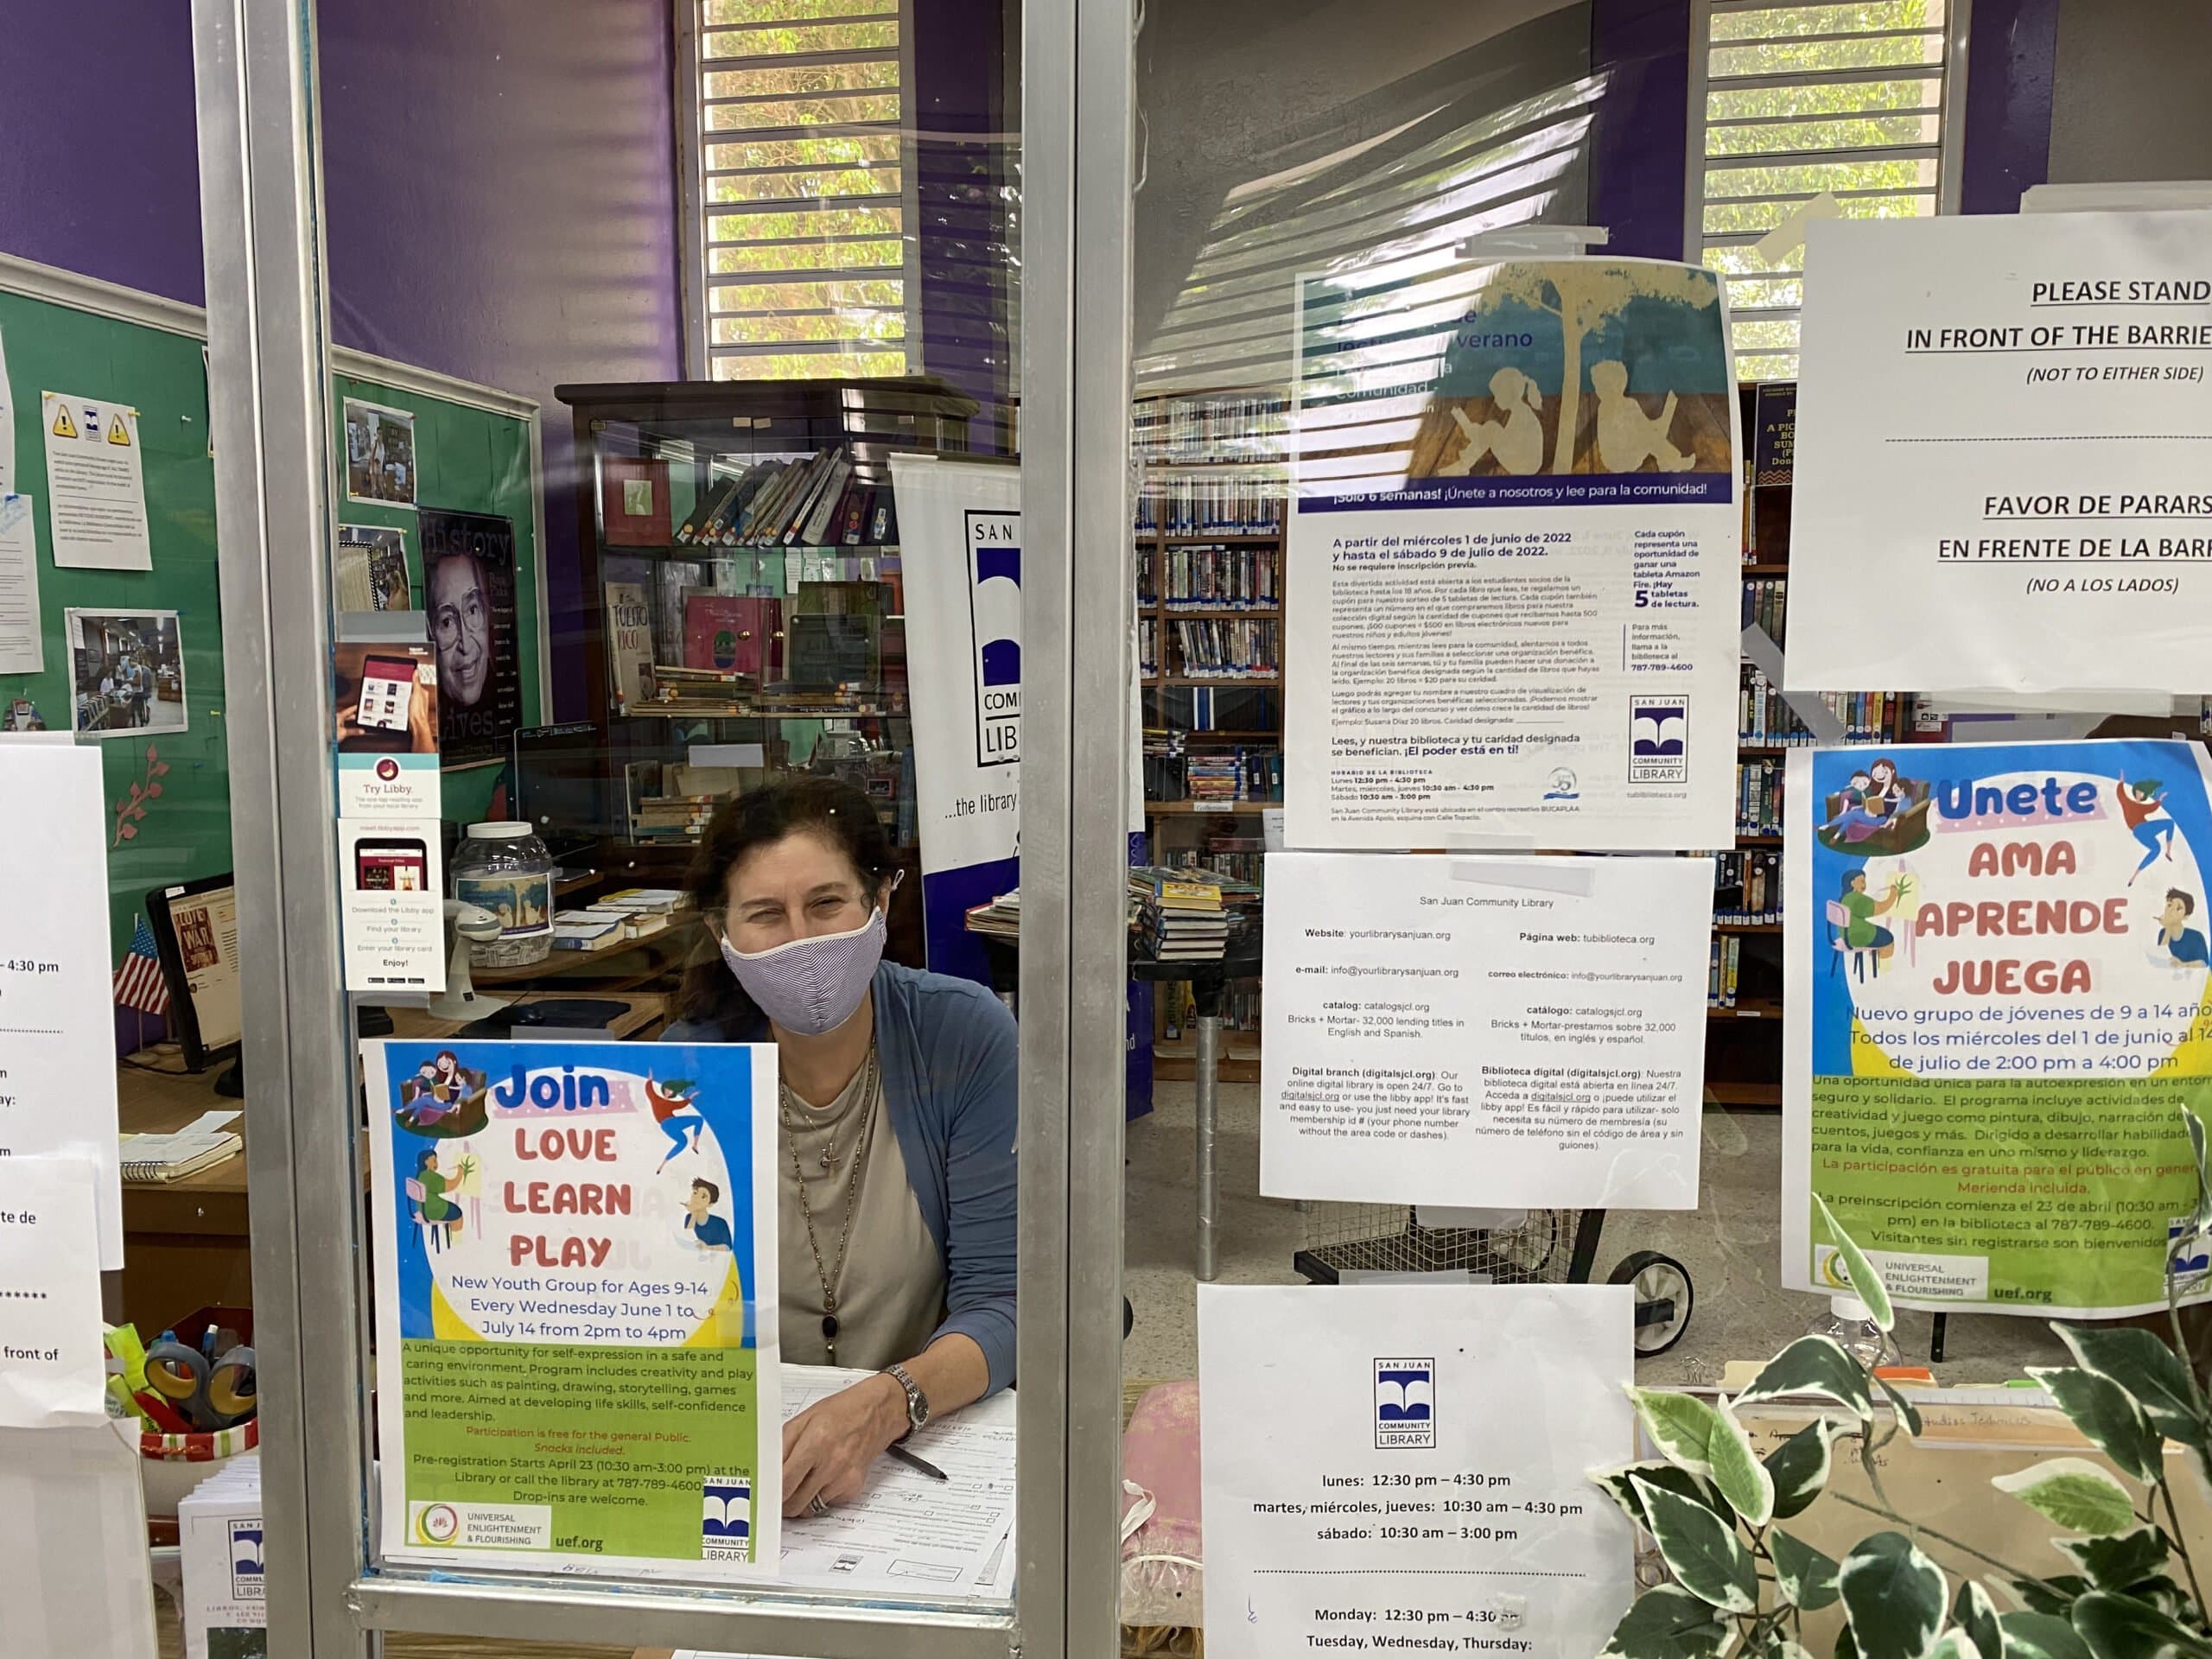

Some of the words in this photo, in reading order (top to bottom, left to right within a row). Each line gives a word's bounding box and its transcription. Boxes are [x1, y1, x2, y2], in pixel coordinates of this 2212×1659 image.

[2033, 280, 2120, 302] PLEASE
[2129, 281, 2210, 301] STAND
[1457, 333, 1532, 348] verano
[1908, 329, 1931, 348] IN
[1941, 328, 2023, 348] FRONT
[2031, 327, 2063, 346] OF
[2073, 325, 2119, 346] THE
[2027, 367, 2071, 385] (NOT
[2076, 367, 2098, 381] TO
[2103, 366, 2159, 380] EITHER
[2164, 366, 2203, 383] SIDE)
[1445, 486, 1485, 501] ¡Únete
[1490, 490, 1497, 499] a
[1500, 486, 1554, 499] nosotros
[1555, 489, 1564, 500] y
[1567, 486, 1586, 498] lee
[1589, 487, 1617, 499] para
[1620, 485, 1630, 496] la
[1633, 482, 1707, 496] comunidad!
[1986, 496, 2069, 515] FAVOR
[2079, 495, 2111, 514] DE
[975, 523, 1013, 541] SAN
[424, 518, 511, 566] History
[1940, 539, 1969, 558] EN
[1979, 539, 2070, 557] FRENTE
[2080, 538, 2111, 557] DE
[2121, 538, 2150, 557] LA
[1333, 561, 1344, 572] No
[1359, 562, 1395, 572] requiere
[1398, 562, 1445, 571] inscripción
[1447, 560, 1477, 571] previa.
[2027, 578, 2059, 595] (NO
[2063, 579, 2075, 592] A
[2082, 579, 2113, 592] LOS
[2118, 577, 2178, 594] LADOS)
[1635, 590, 1649, 608] 5
[1631, 663, 1693, 671] 787-789-4600
[986, 725, 1017, 753] LIB
[1633, 768, 1682, 779] LIBRARY
[363, 785, 380, 794] Try
[979, 791, 1017, 817] library
[1935, 778, 2097, 819] Unete
[1968, 842, 2076, 878] AMA
[1420, 896, 1438, 906] San
[1440, 896, 1464, 906] Juan
[1466, 897, 1519, 909] Community
[1522, 898, 1554, 910] Library
[1916, 898, 2129, 937] APRENDE
[182, 926, 209, 950] WAR
[1350, 930, 1451, 942] yourlibrarysanjuan.org
[1520, 932, 1554, 943] Página
[1556, 933, 1580, 943] web:
[1584, 934, 1655, 946] tubiblioteca.org
[8, 960, 34, 971] 4:30
[39, 963, 58, 975] pm
[1296, 965, 1328, 975] e-mail:
[1332, 965, 1459, 979] info@yourlibrarysanjuan.org
[1933, 959, 2092, 995] JUEGA
[1850, 1004, 1908, 1021] Nuevo
[1914, 1010, 1974, 1025] grupo
[1980, 1007, 2003, 1021] de
[2006, 1006, 2084, 1023] jóvenes
[2090, 1005, 2114, 1020] de
[2120, 1006, 2132, 1020] 9
[2138, 1007, 2147, 1019] a
[2153, 1004, 2172, 1018] 14
[497, 1065, 610, 1113] Join
[516, 1128, 616, 1161] LOVE
[504, 1182, 631, 1215] LEARN
[20, 1211, 35, 1224] de
[511, 1236, 612, 1268] PLAY
[453, 1275, 488, 1289] New
[492, 1276, 540, 1292] Youth
[546, 1279, 597, 1295] Group
[601, 1279, 624, 1294] for
[628, 1281, 670, 1298] Ages
[674, 1281, 708, 1295] 9-14
[1992, 1287, 2052, 1304] uef.org
[4, 1345, 40, 1360] front
[44, 1348, 58, 1360] of
[1379, 1421, 1430, 1430] COMMUNITY
[1380, 1433, 1430, 1445] LIBRARY
[1323, 1474, 1363, 1486] lunes:
[1373, 1474, 1410, 1485] 12:30
[1415, 1476, 1436, 1488] pm
[1453, 1473, 1484, 1485] 4:30
[1489, 1477, 1510, 1488] pm
[1254, 1503, 1307, 1516] martes,
[1311, 1500, 1382, 1514] miércoles,
[1385, 1500, 1434, 1514] jueves:
[1444, 1501, 1482, 1512] 10:30
[1486, 1503, 1507, 1513] am
[1525, 1501, 1555, 1514] 4:30
[1560, 1505, 1582, 1516] pm
[467, 1512, 515, 1522] UNIVERSAL
[467, 1524, 541, 1534] ENLIGHTENMENT
[1318, 1526, 1372, 1541] sábado:
[1381, 1527, 1418, 1538] 10:30
[1422, 1529, 1443, 1538] am
[1461, 1527, 1491, 1539] 3:00
[1496, 1530, 1516, 1541] pm
[475, 1535, 531, 1545] FLOURISHING
[556, 1535, 603, 1552] uef.org
[701, 1549, 748, 1562] LIBRARY
[1316, 1608, 1376, 1623] Monday:
[1385, 1610, 1422, 1622] 12:30
[1427, 1612, 1449, 1624] pm
[1466, 1611, 1496, 1622] 4:30
[1306, 1635, 1368, 1649] Tuesday,
[1372, 1635, 1458, 1652] Wednesday,
[1463, 1637, 1531, 1652] Thursday:
